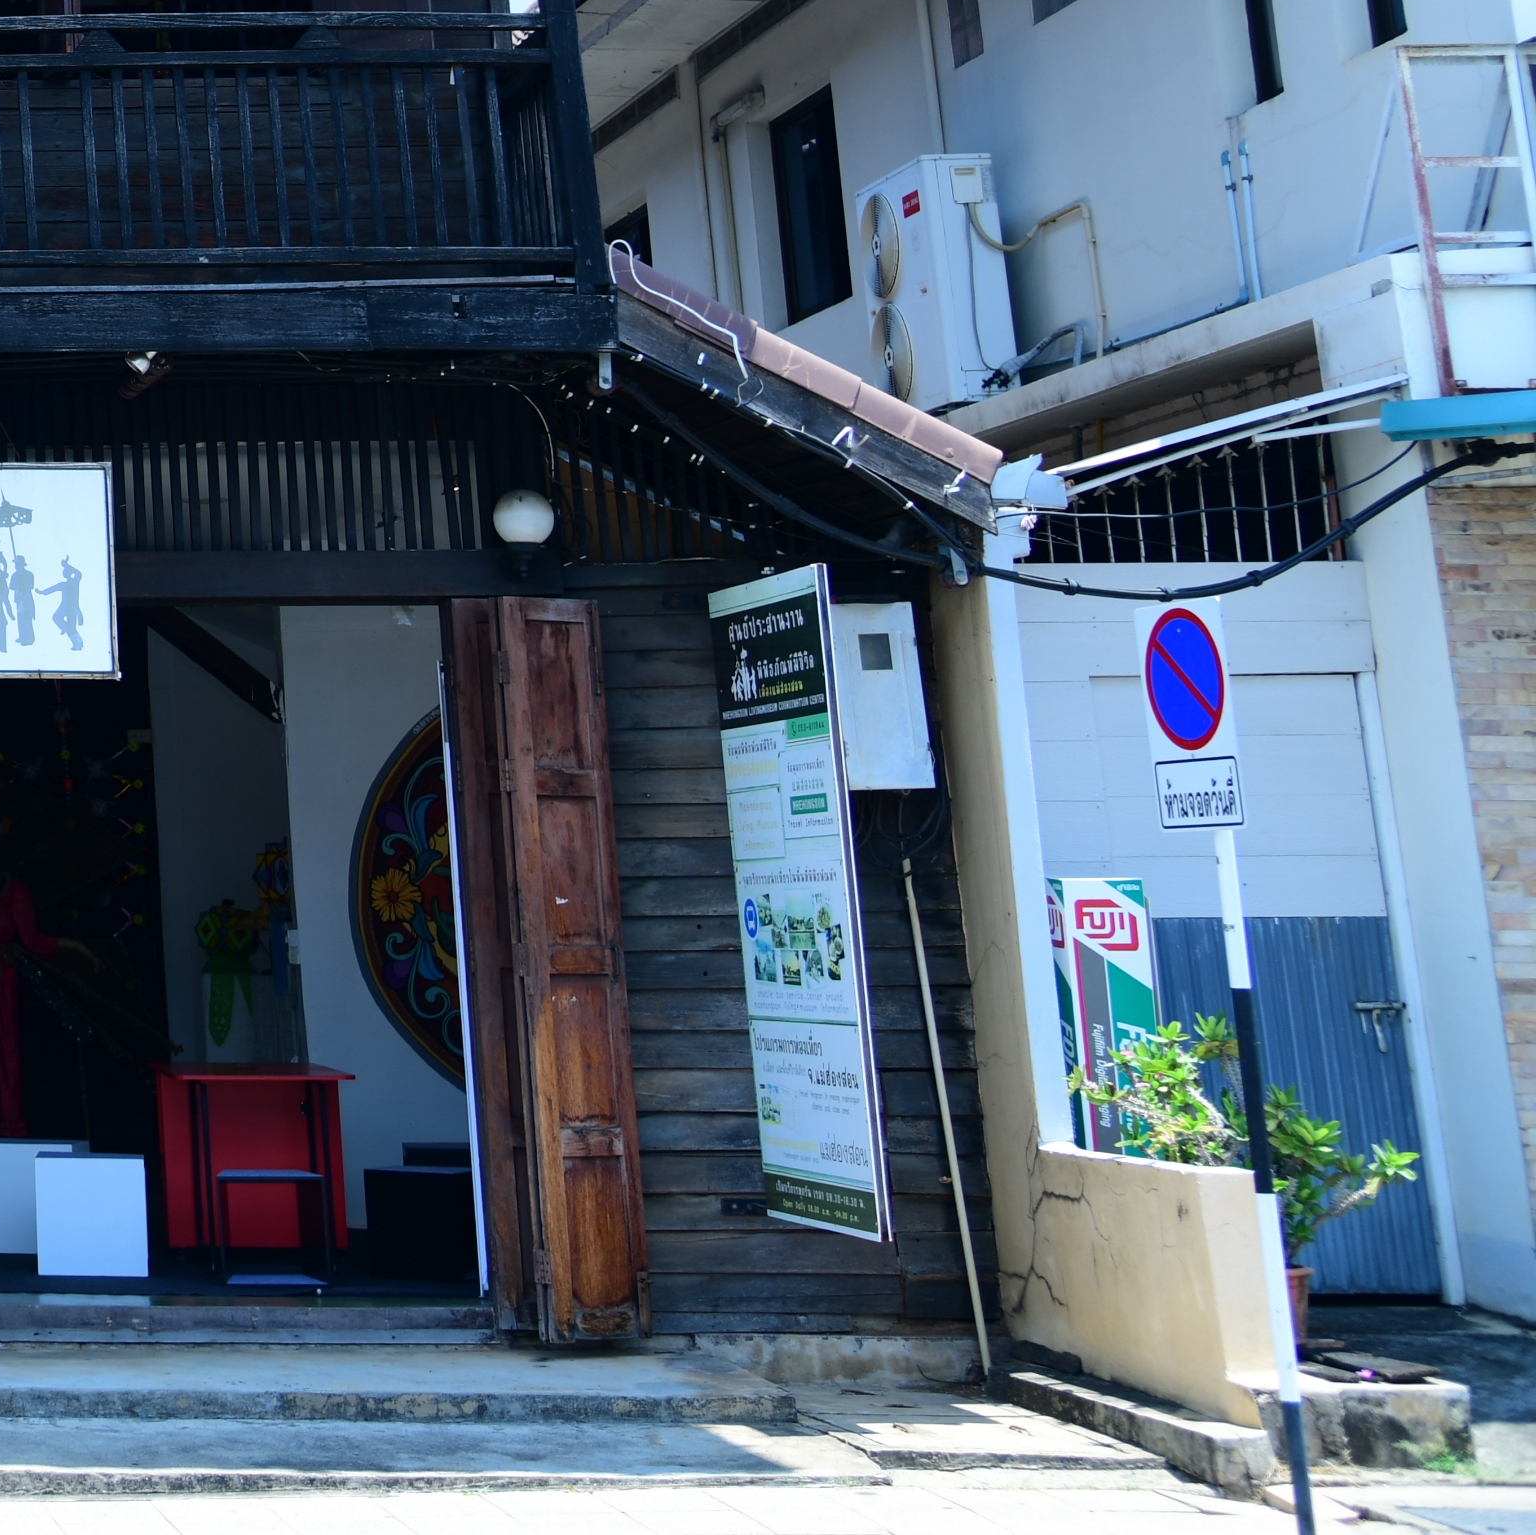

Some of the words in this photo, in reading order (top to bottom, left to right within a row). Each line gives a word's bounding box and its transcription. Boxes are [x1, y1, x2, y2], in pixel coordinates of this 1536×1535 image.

[728, 607, 804, 650] ศูนย์ประสานงาน
[1164, 766, 1238, 819] ห้ามจอดวันคี่
[1074, 899, 1139, 951] FUJI
[1092, 1023, 1106, 1056] Fujifilm
